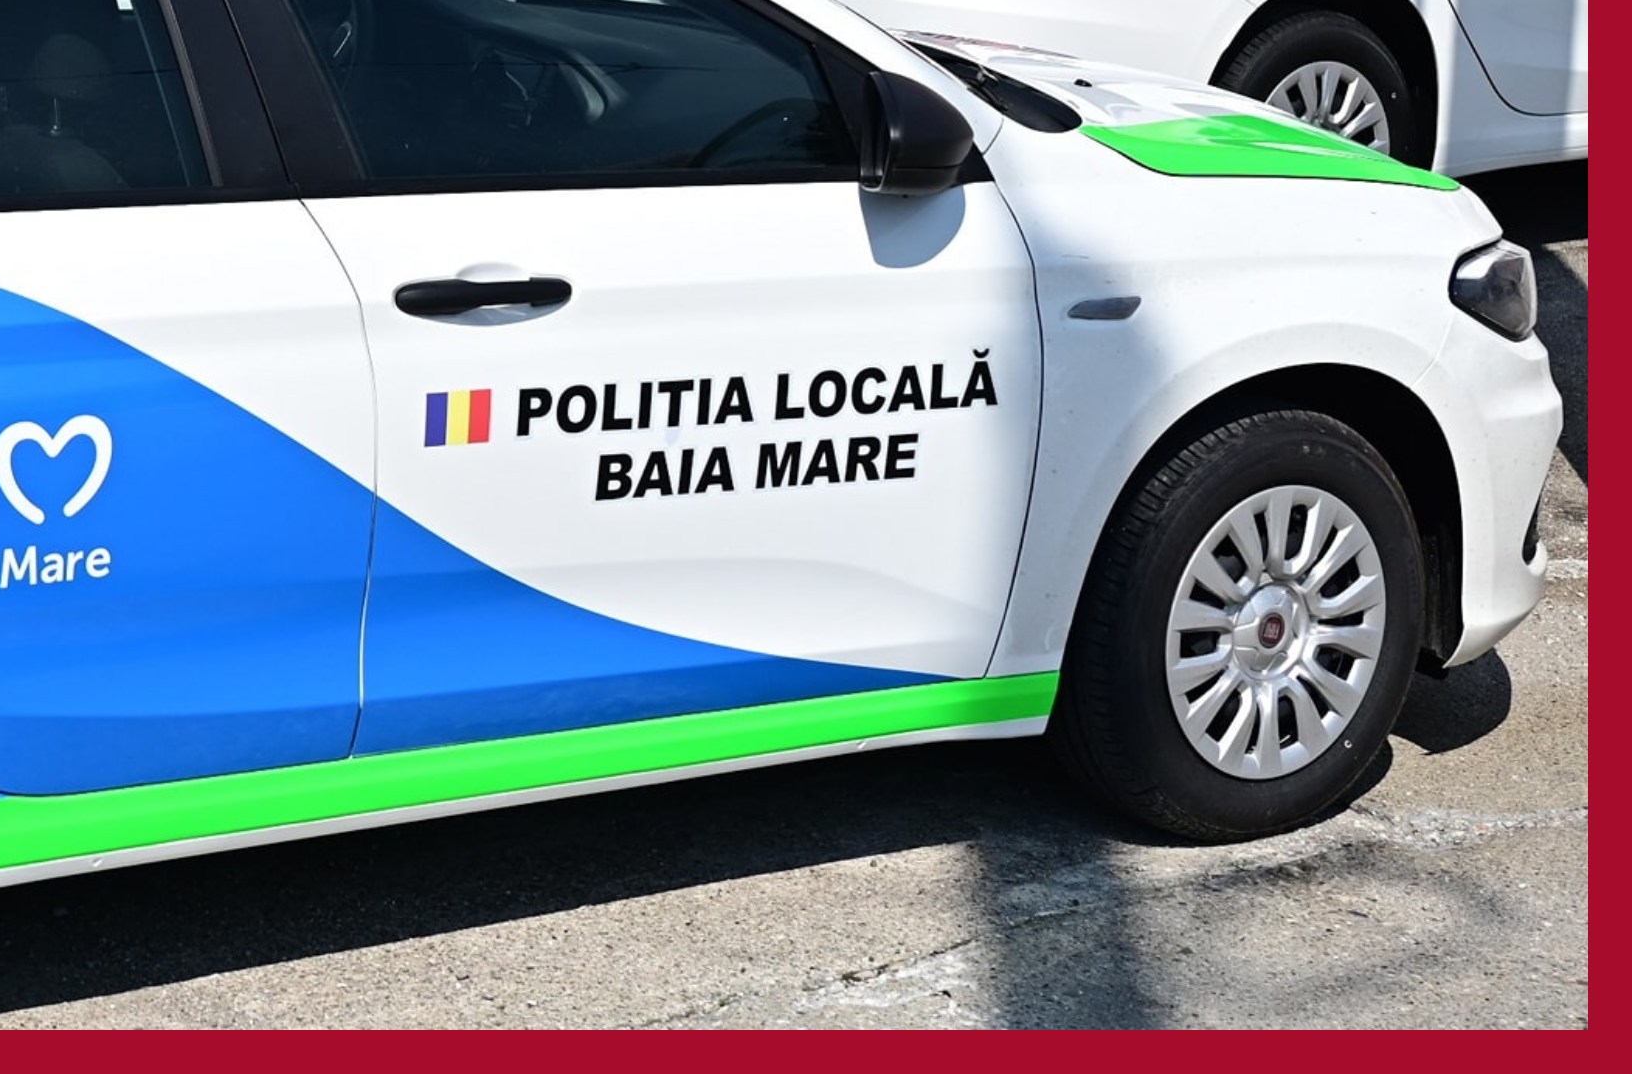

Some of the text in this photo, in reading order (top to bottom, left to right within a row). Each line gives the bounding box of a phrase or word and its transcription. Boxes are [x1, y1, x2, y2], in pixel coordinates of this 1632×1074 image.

[516, 348, 999, 437] POLITIA LOCALĂ
[594, 432, 920, 502] BAIA MARE
[0, 545, 112, 590] Mare
